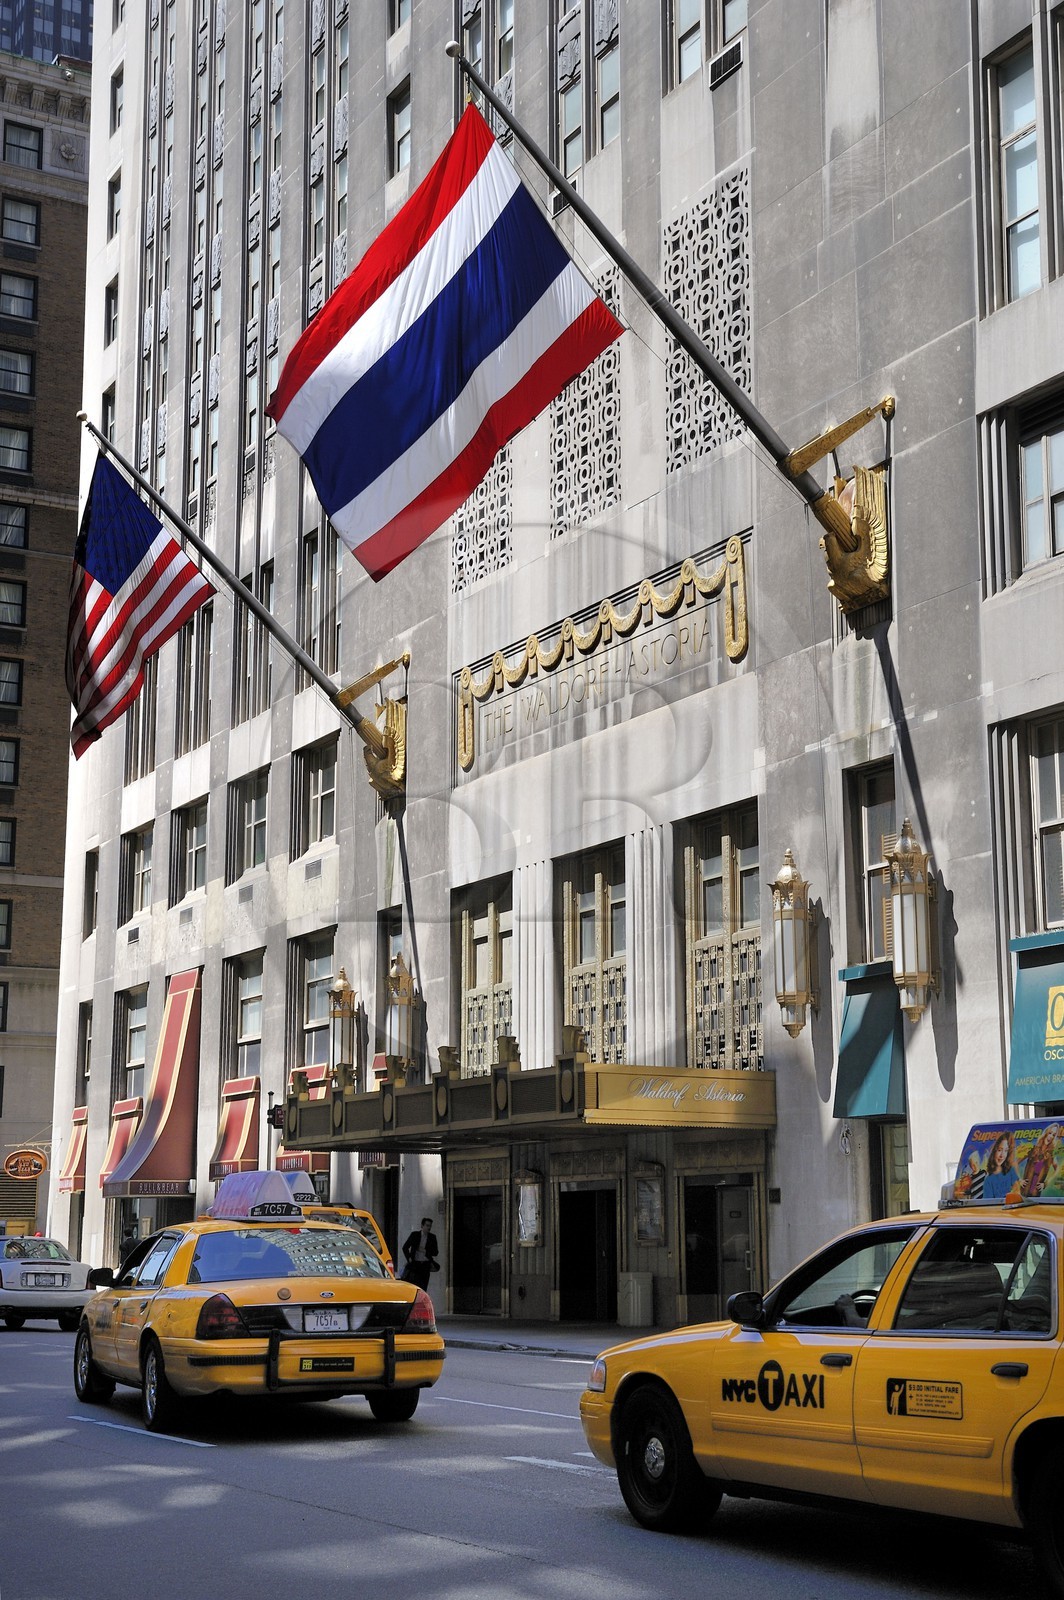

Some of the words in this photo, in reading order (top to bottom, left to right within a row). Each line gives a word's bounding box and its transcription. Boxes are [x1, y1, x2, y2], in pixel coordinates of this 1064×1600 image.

[483, 703, 515, 742] THE
[1044, 1048, 1064, 1061] OSC
[1015, 1075, 1051, 1087] AMERICAN
[627, 1076, 691, 1110] Waldorf
[693, 1080, 747, 1103] Astoria
[1013, 1128, 1043, 1144] mega
[264, 1204, 287, 1214] 7C57
[721, 1378, 757, 1403] NYC
[758, 1360, 825, 1411] TAXI
